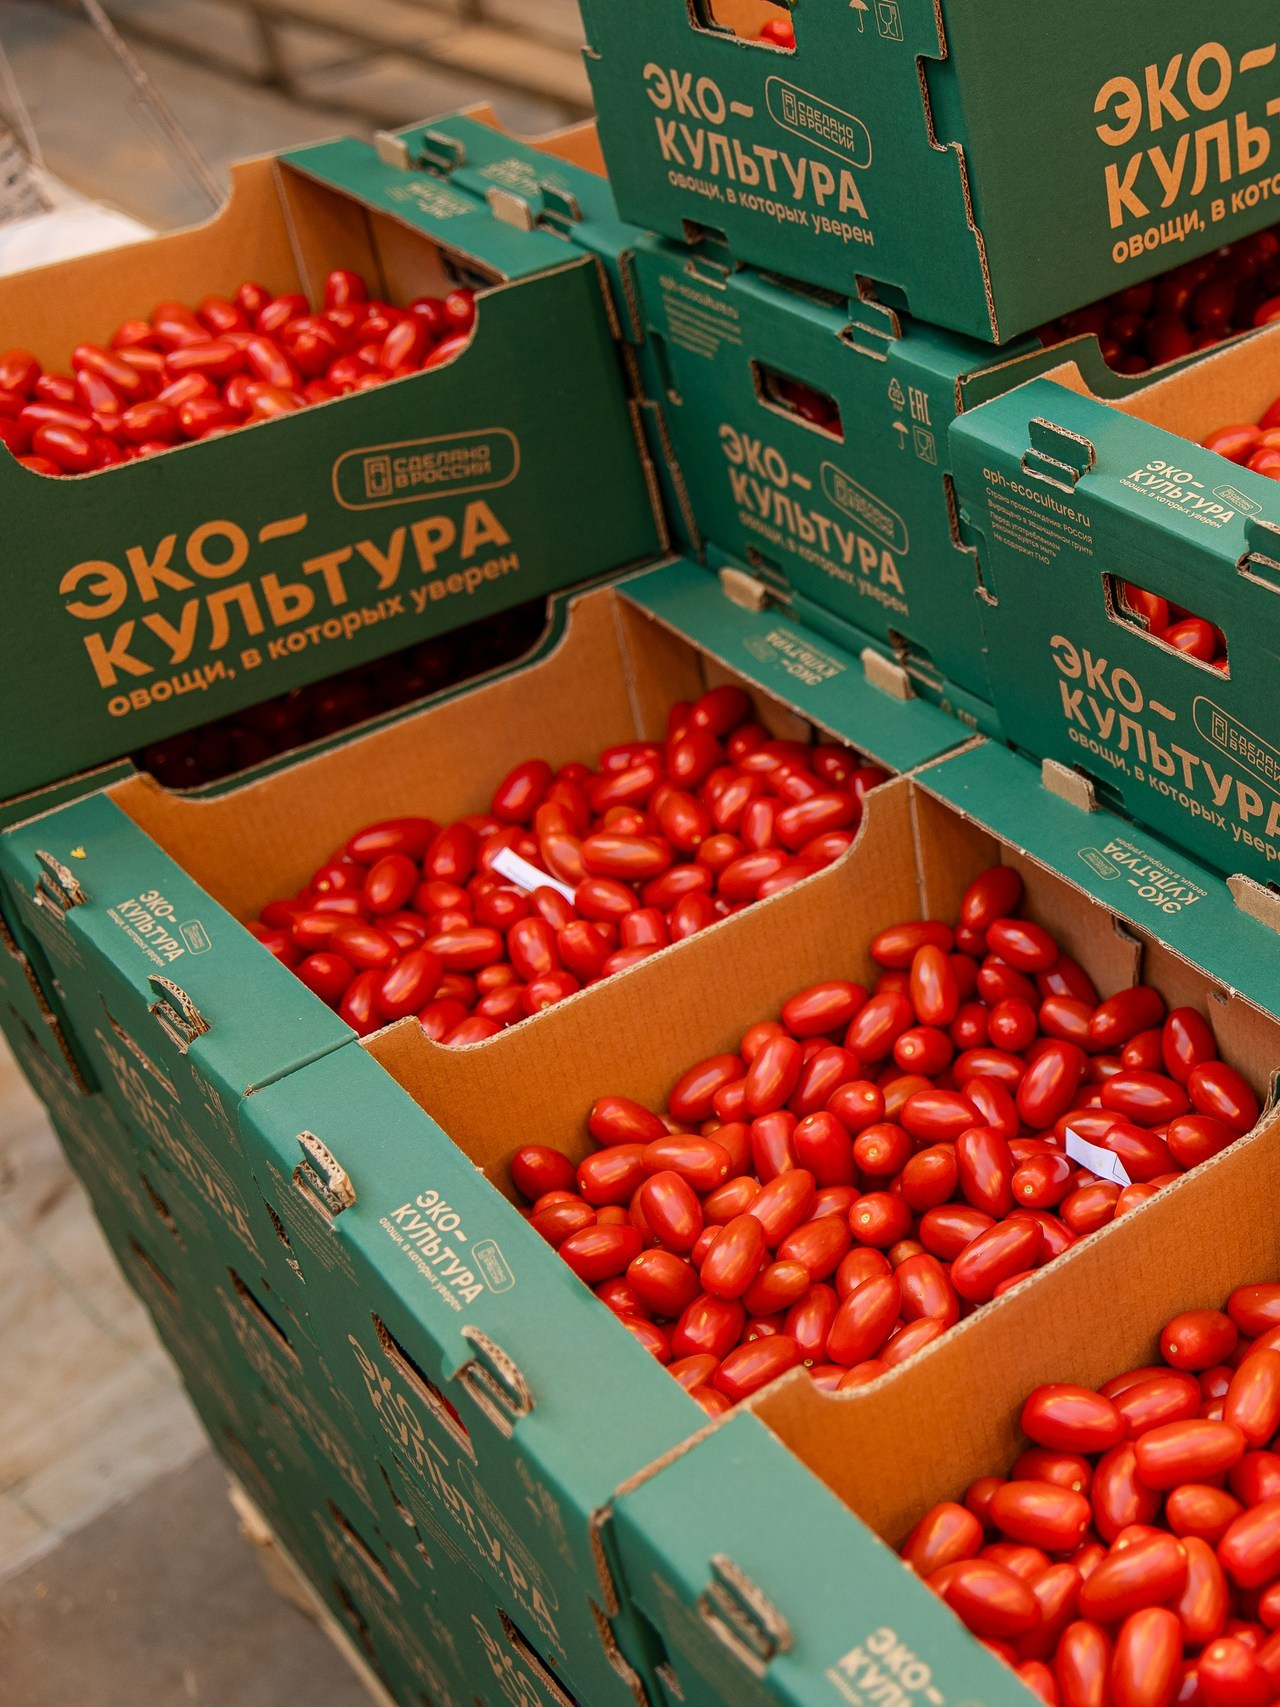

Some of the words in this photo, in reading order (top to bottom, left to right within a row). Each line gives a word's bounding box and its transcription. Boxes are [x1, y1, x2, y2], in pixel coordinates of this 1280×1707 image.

[643, 62, 754, 125] ЭКО-
[798, 101, 854, 139] СДЕЛАНО
[1093, 41, 1277, 147] ЭКО-
[654, 116, 869, 219] КУЛЬТУРА
[808, 119, 856, 152] РОССИИ
[668, 171, 725, 204] овощи,
[727, 189, 738, 203] в
[739, 192, 808, 226] которых
[812, 213, 875, 246] уверен
[1112, 208, 1205, 264] овощи,
[1211, 198, 1225, 221] в
[393, 444, 490, 473] СДЕЛАНО
[718, 422, 812, 490] ЭКО-
[1146, 460, 1206, 488] ЭКО-
[983, 467, 1090, 528] aph-ecoculture.ru
[1127, 469, 1236, 524] КУЛЬТУРА
[1154, 494, 1192, 515] которых
[1188, 509, 1223, 529] уверен
[727, 465, 905, 595] КУЛЬТУРА
[58, 512, 308, 620] ЭКО-
[83, 500, 512, 688] КУЛЬТУРА
[107, 661, 235, 717] овощи,
[241, 648, 262, 670] в
[267, 594, 406, 660] которых
[409, 552, 520, 612] уверен
[1050, 634, 1176, 714] ЭКО-
[1068, 727, 1131, 776] овощи,
[1134, 764, 1146, 781] в
[1149, 773, 1227, 832] которых
[139, 889, 177, 922] ЭКО-
[1102, 842, 1200, 906] КУЛЬТУРА
[1127, 878, 1182, 914] ЭКО-
[117, 898, 185, 962] КУЛЬТУРА
[416, 1190, 468, 1242] ЭКО-
[390, 1202, 484, 1304] КУЛЬТУРА
